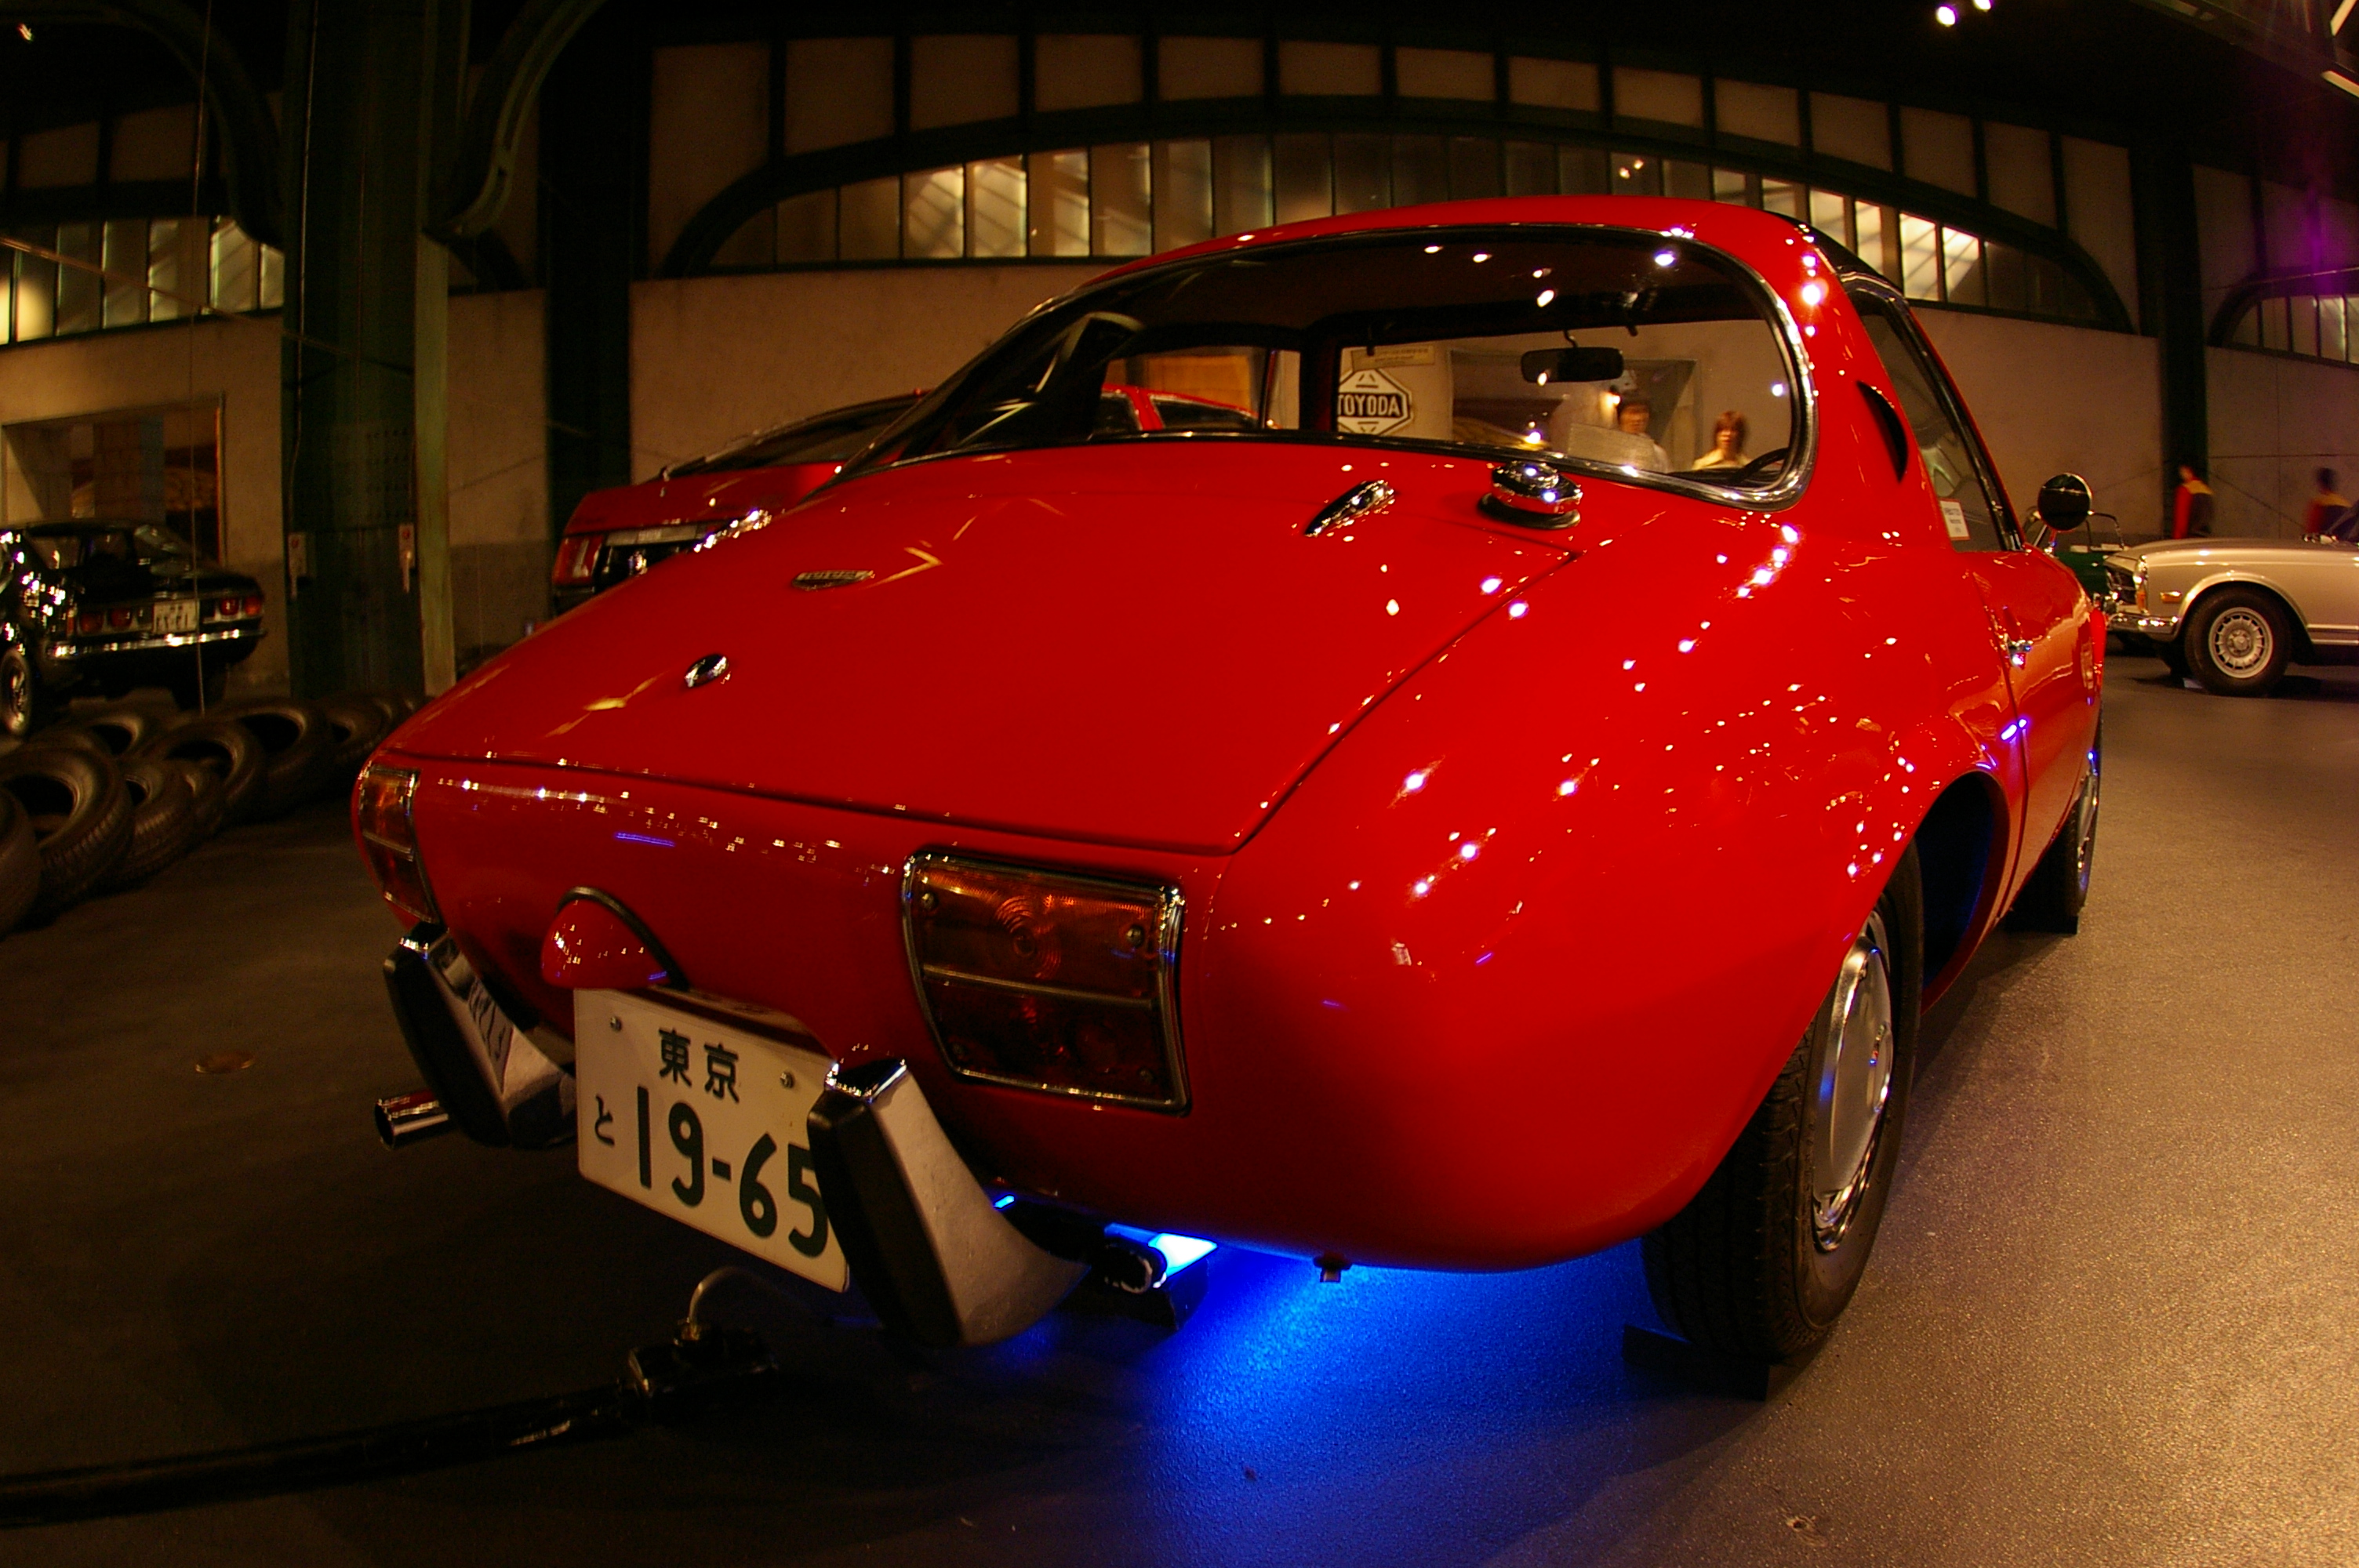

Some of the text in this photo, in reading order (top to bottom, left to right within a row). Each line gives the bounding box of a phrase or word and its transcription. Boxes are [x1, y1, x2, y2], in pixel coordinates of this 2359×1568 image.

[1337, 394, 1401, 416] TOYODA
[659, 1029, 740, 1104] 東京
[594, 1085, 830, 1258] と 19-65
